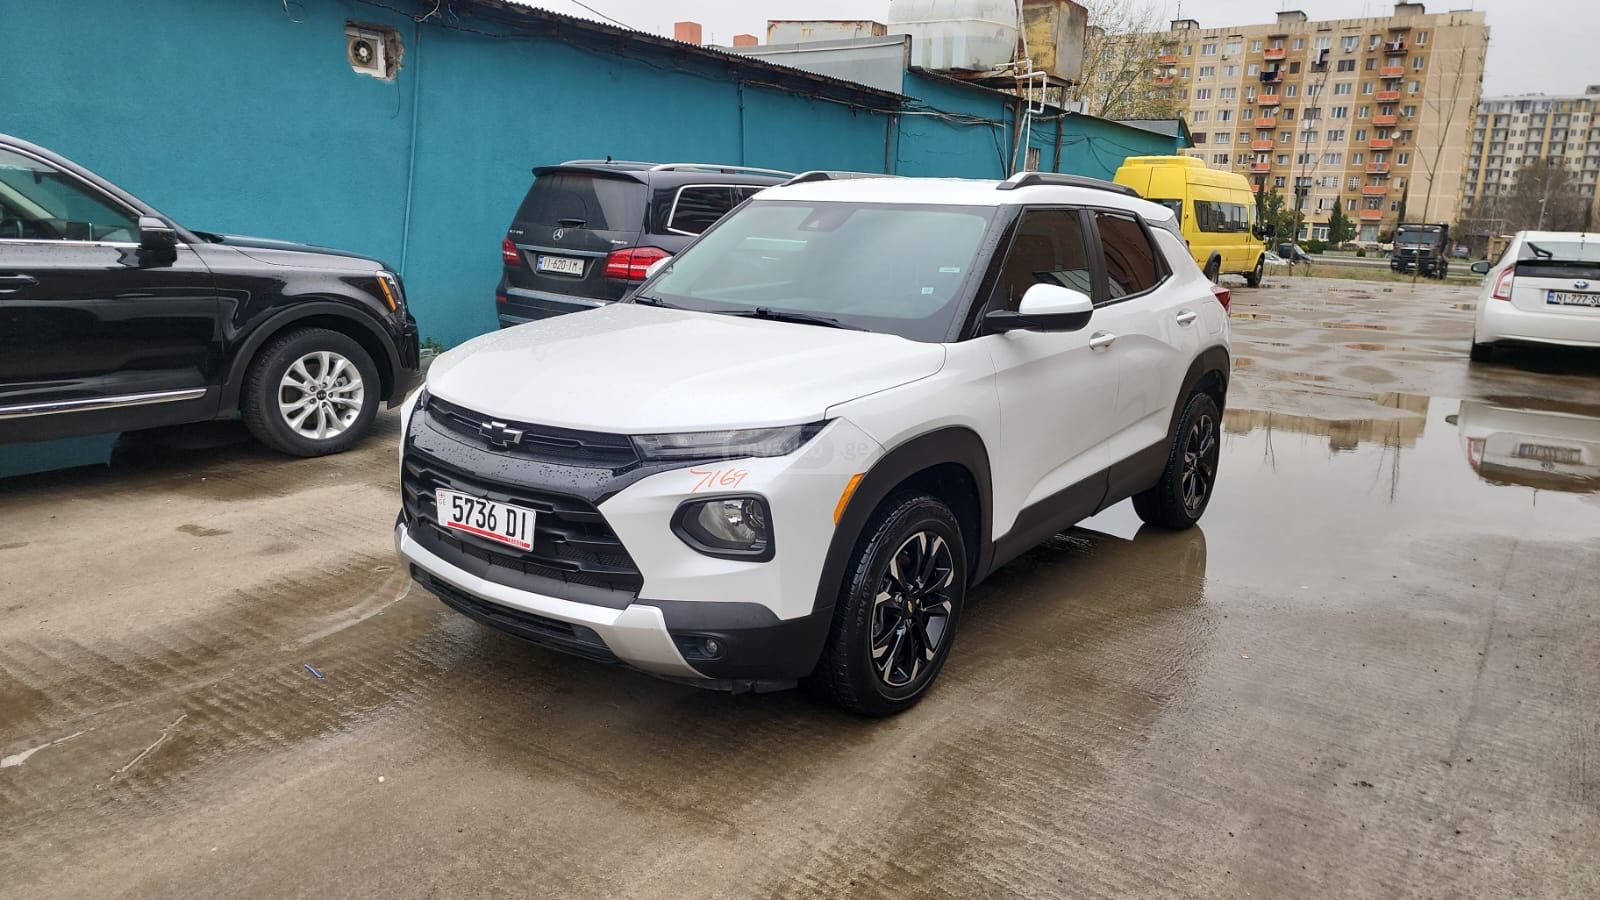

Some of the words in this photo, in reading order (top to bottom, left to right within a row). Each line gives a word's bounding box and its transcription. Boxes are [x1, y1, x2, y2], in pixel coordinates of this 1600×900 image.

[690, 468, 749, 493] 7169
[452, 495, 497, 531] 5736
[505, 507, 526, 540] DI
